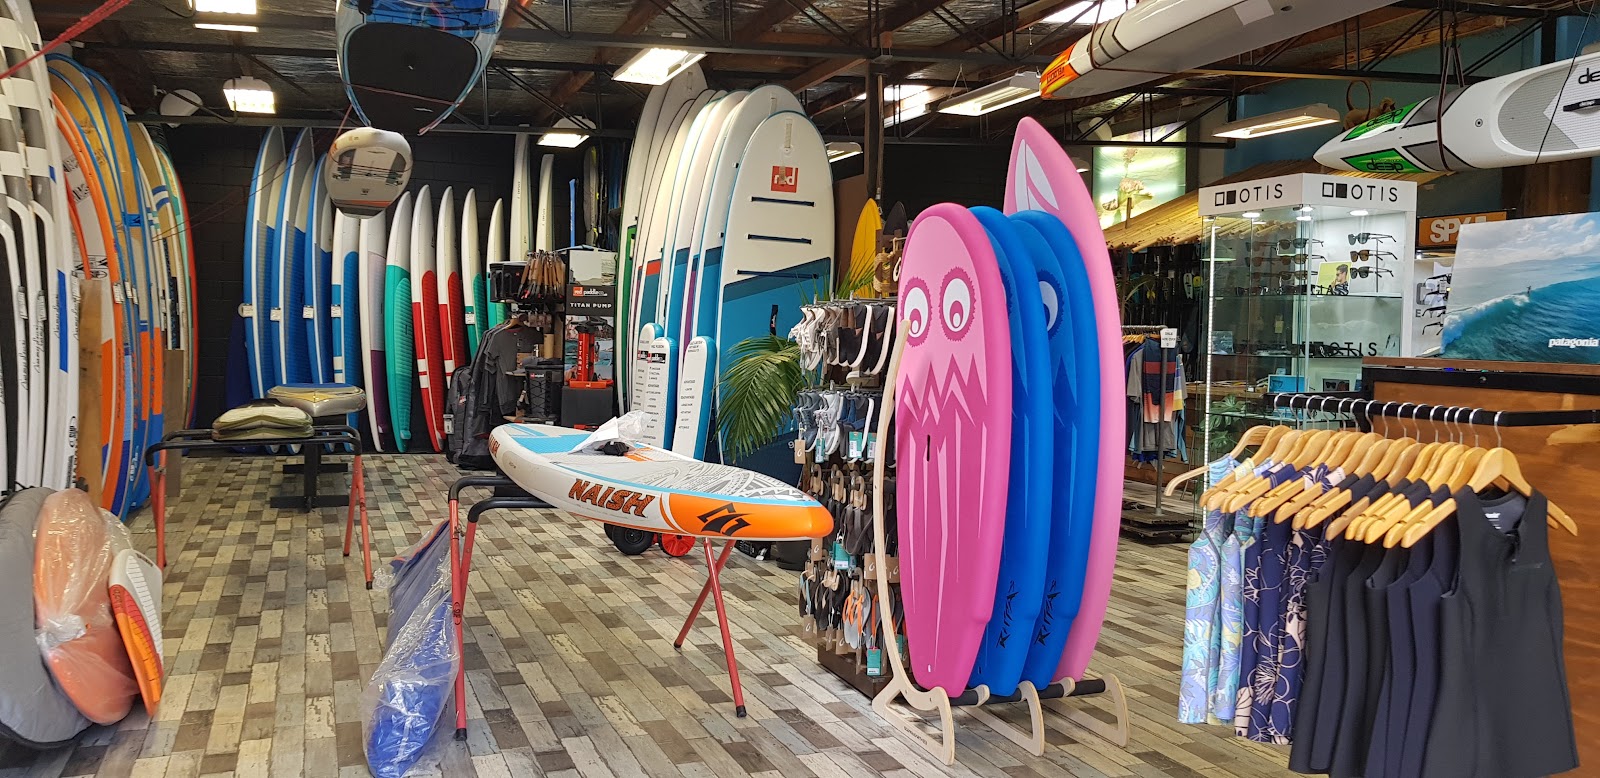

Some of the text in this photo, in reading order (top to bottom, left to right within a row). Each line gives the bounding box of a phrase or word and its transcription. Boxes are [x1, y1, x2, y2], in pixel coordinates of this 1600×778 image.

[1239, 183, 1283, 203] OTIS
[1351, 183, 1398, 202] OTIS
[1330, 341, 1377, 356] OTIS
[1548, 337, 1599, 348] patagonia
[568, 478, 655, 518] NAISH
